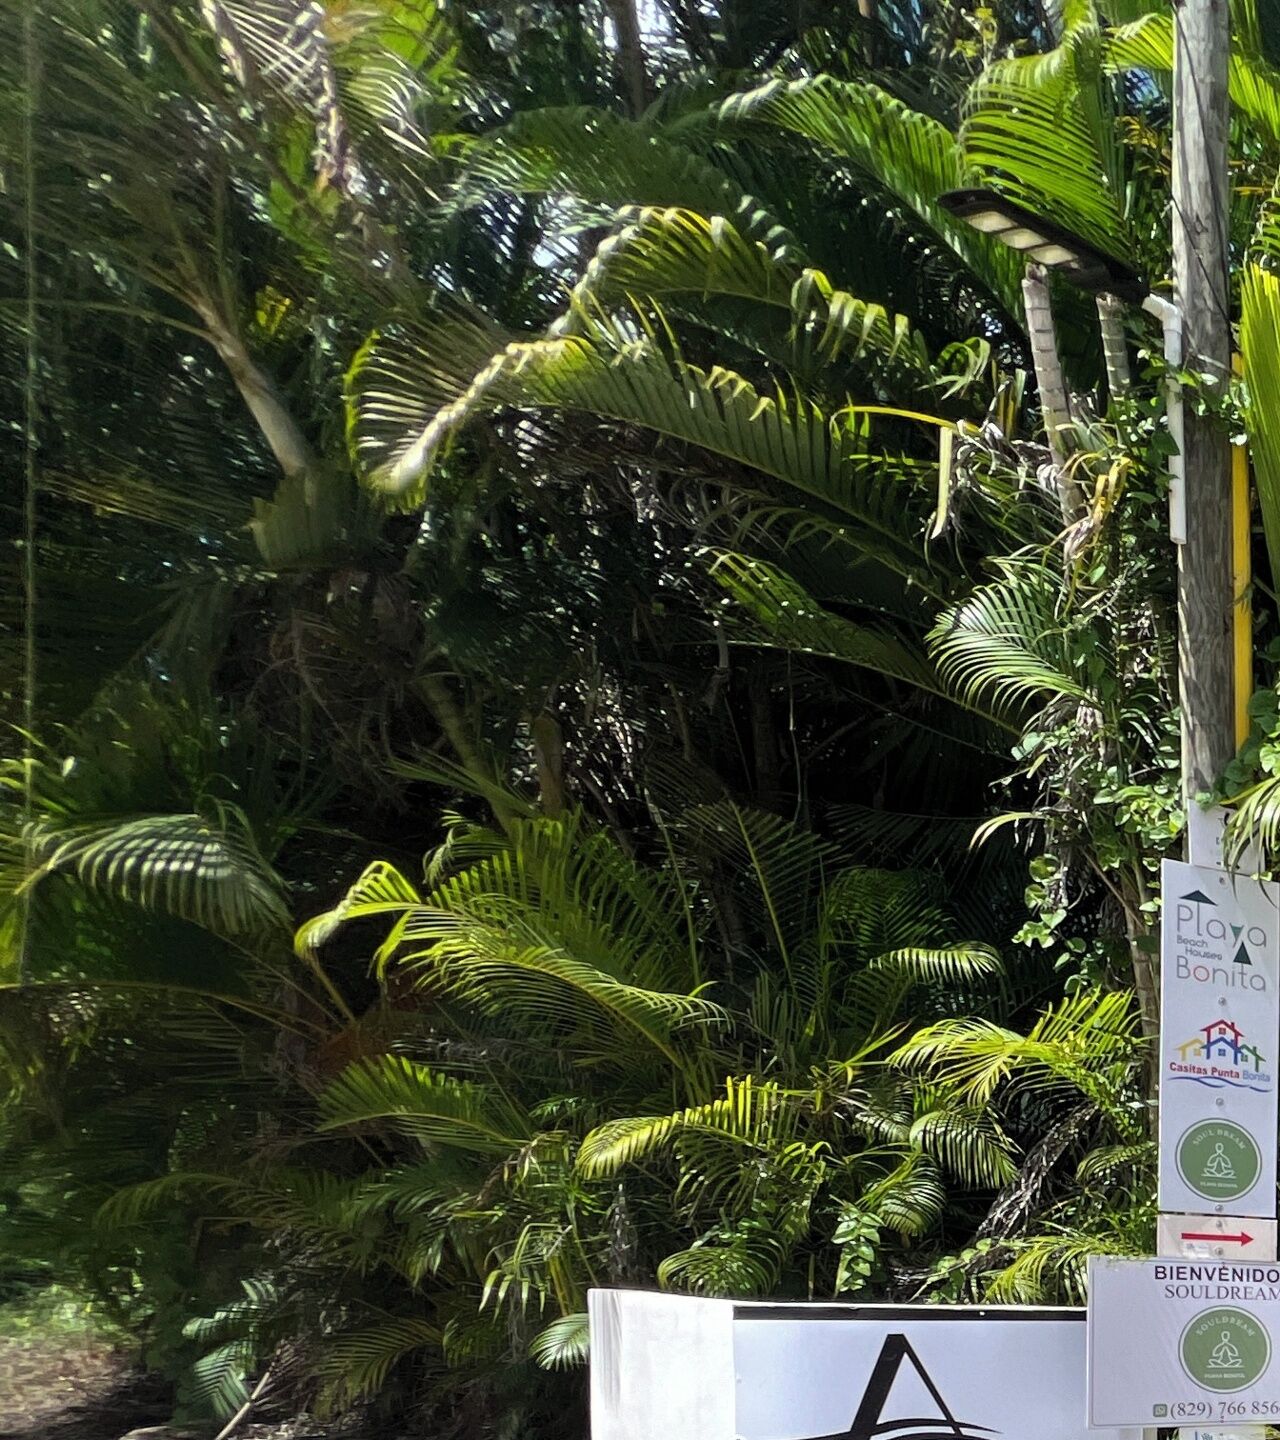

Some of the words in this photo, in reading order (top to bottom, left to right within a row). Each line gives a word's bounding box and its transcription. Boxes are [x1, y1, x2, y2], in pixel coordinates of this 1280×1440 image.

[1177, 901, 1266, 948] Playa
[1176, 935, 1208, 948] Beach
[1185, 947, 1222, 961] Houses
[1176, 955, 1266, 992] Bonita
[1169, 1062, 1207, 1075] Casitas
[1211, 1067, 1240, 1079] Punta
[1243, 1070, 1271, 1082] Bonita
[1196, 1316, 1256, 1337] SOULDREAM
[1170, 1402, 1212, 1419] (829)
[1220, 1402, 1246, 1416] 766
